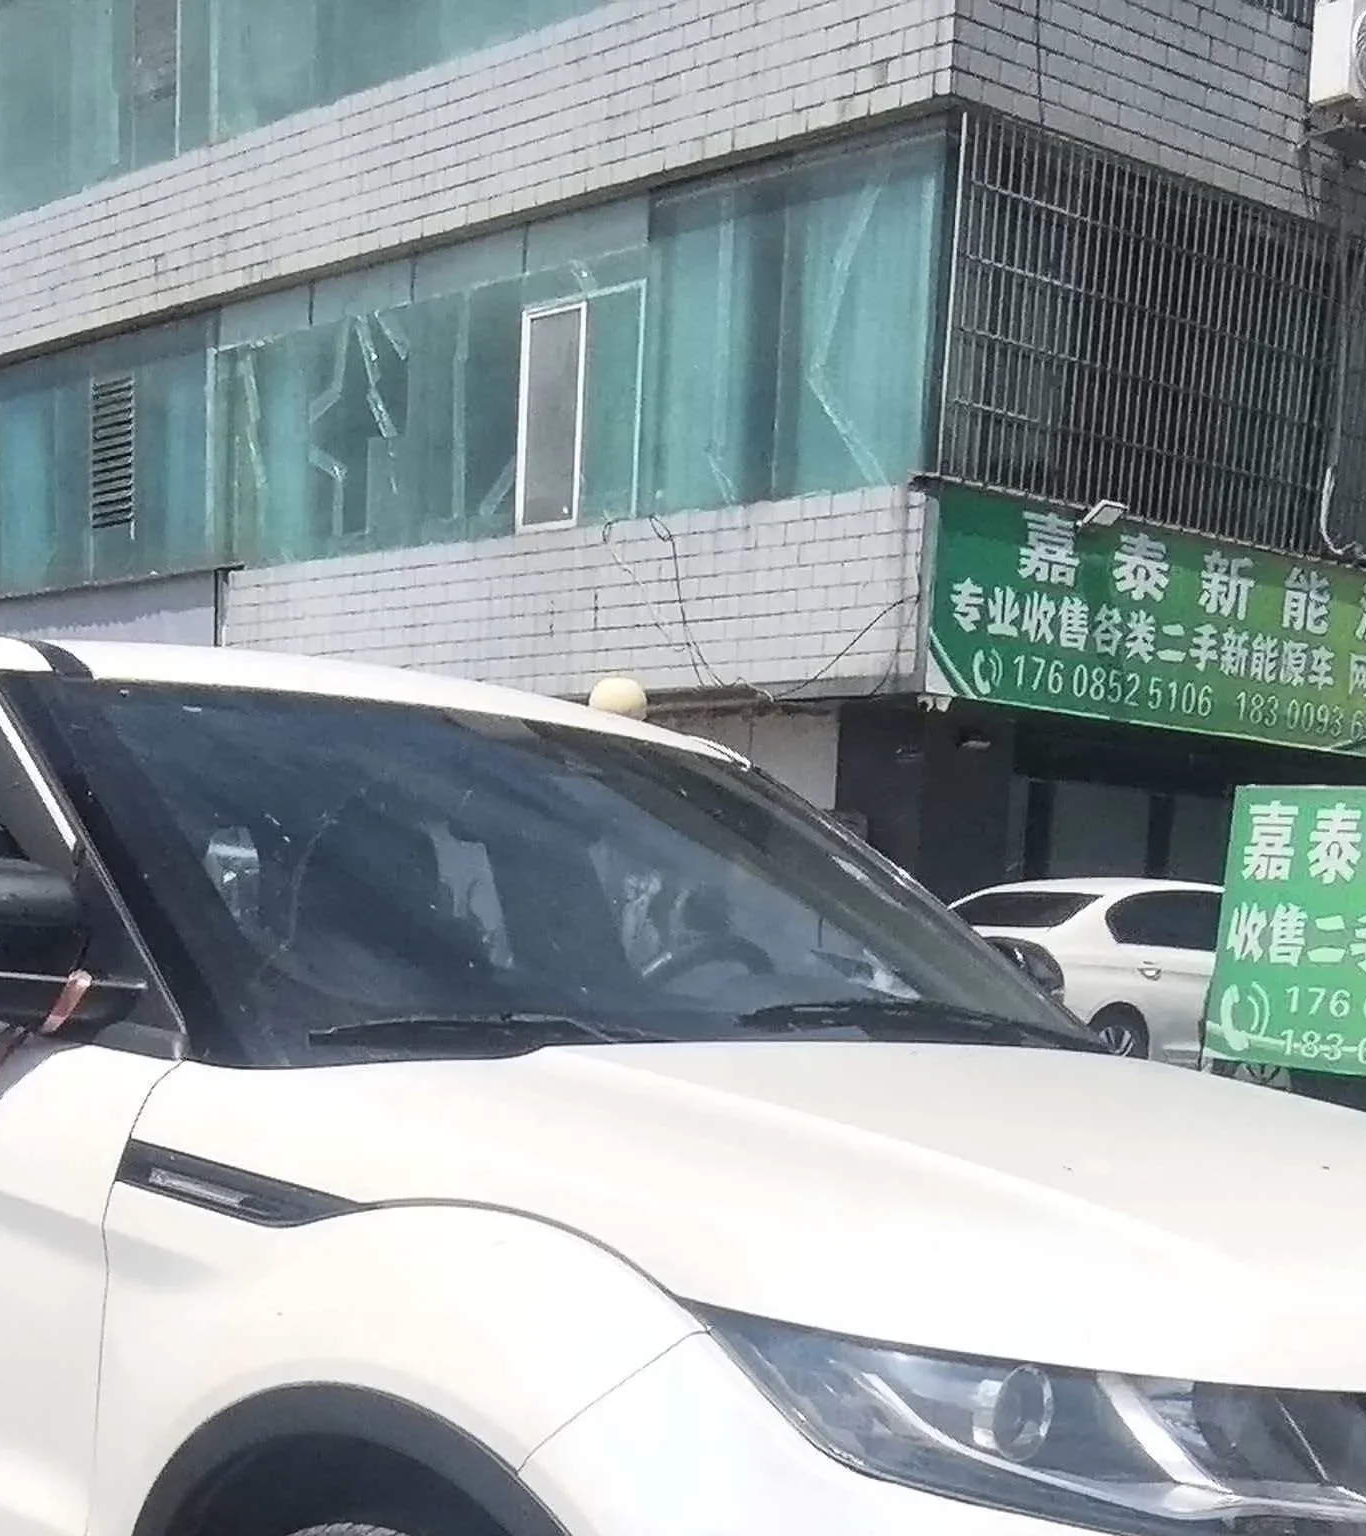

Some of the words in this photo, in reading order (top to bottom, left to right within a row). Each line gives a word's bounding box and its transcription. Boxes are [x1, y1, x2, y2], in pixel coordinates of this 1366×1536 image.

[950, 576, 1335, 690] 专业收售各类二手新能源车
[1012, 655, 1064, 693] 176
[1073, 663, 1139, 706] 0852
[1149, 675, 1213, 718] 5106
[1236, 691, 1278, 728] 183
[1287, 699, 1342, 738] 0093
[1285, 986, 1350, 1018] 176
[1281, 1029, 1345, 1062] 183
